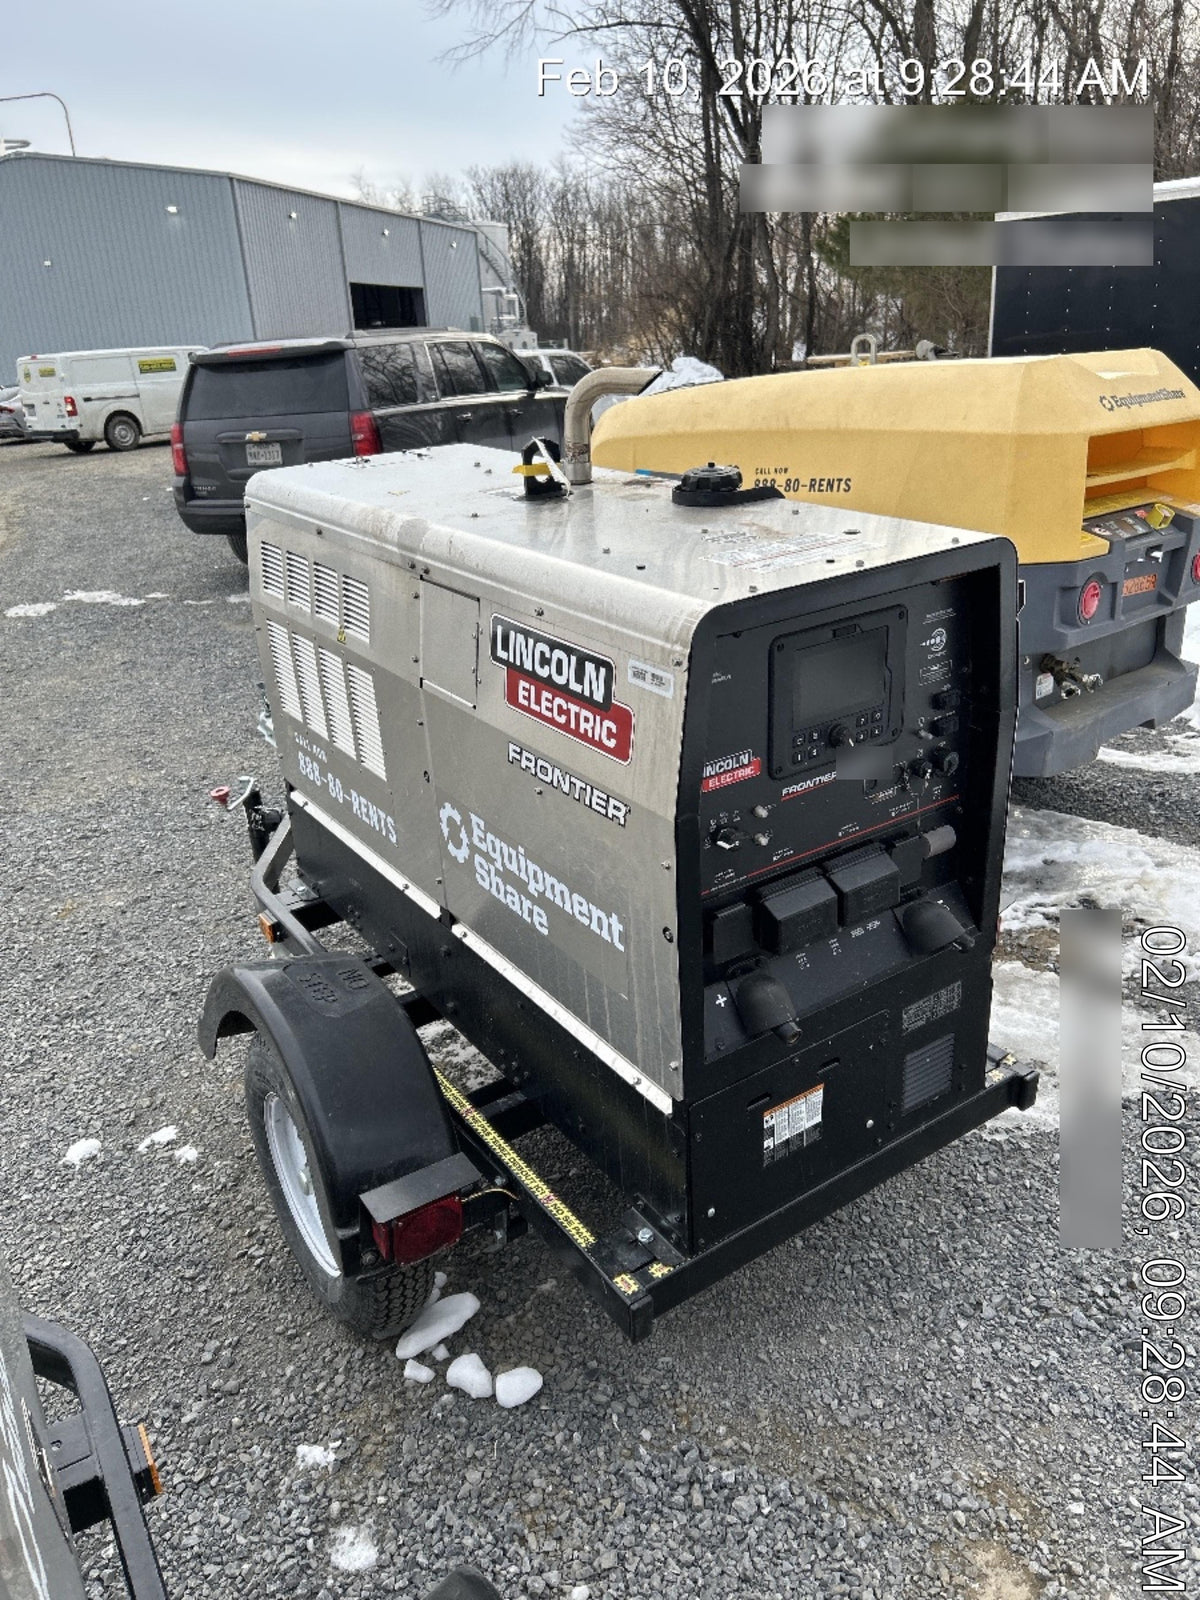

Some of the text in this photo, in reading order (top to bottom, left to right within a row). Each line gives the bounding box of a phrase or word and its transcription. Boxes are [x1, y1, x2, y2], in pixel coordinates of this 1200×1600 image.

[1111, 387, 1186, 409] EquipmentShare
[755, 466, 789, 475] CALL NOW
[754, 478, 852, 493] 888-80-RENTS
[496, 624, 606, 703] LINCOLN
[518, 679, 617, 748] ELECTRIC
[703, 753, 749, 778] INCOLN
[708, 766, 754, 788] ELECTRIC
[298, 751, 398, 845] 888-80-RENTS
[508, 742, 629, 828] FRONTIER
[469, 811, 625, 953] Equipment
[474, 853, 549, 936] Share
[297, 972, 339, 1003] STEP
[338, 968, 370, 991] NO
[551, 1202, 565, 1216] NO
[562, 1215, 576, 1227] SE
